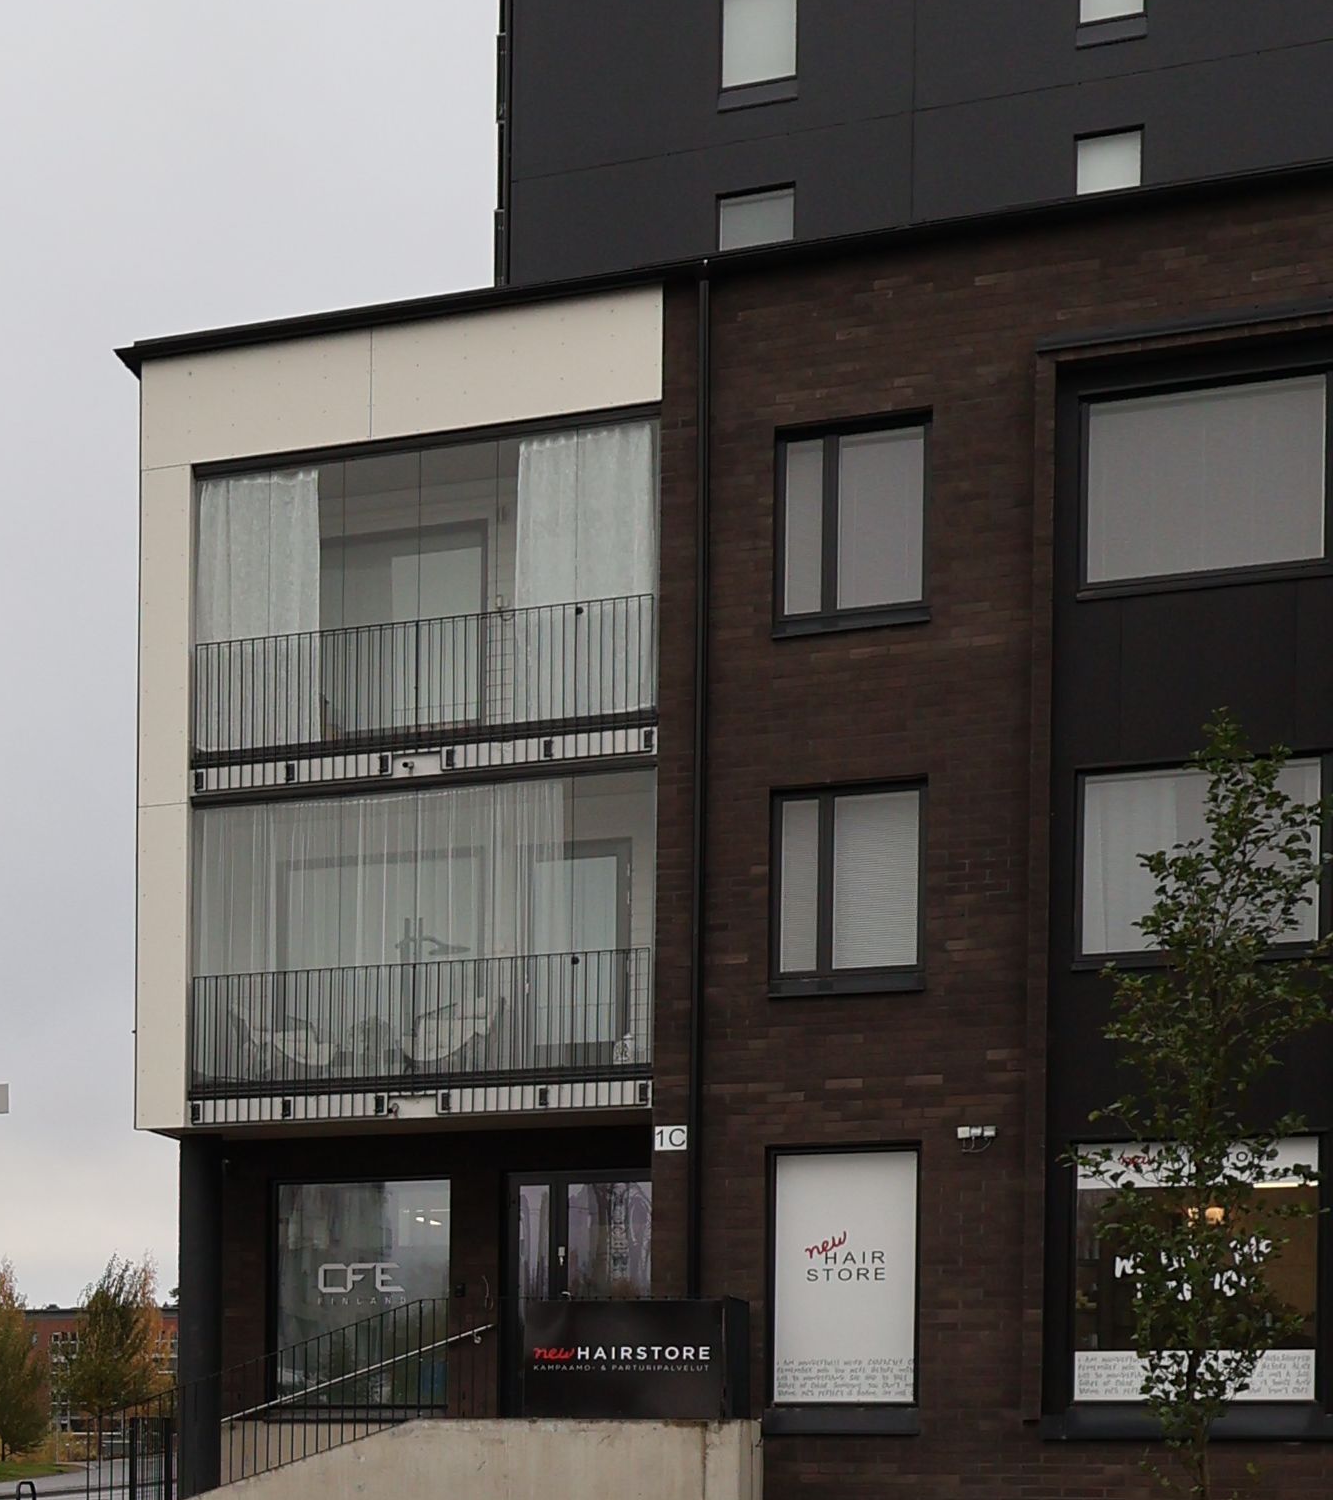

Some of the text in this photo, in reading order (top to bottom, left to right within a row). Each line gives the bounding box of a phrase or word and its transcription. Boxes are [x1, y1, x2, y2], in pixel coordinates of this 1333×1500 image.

[656, 1127, 686, 1148] 1C
[804, 1230, 847, 1260] new
[824, 1250, 885, 1265] HAIR
[806, 1267, 886, 1282] STORE
[317, 1297, 406, 1306] FINLAND
[533, 1345, 711, 1361] new HAIRSTORE
[533, 1363, 710, 1372] KAMPAAMO- & PARTURIPALVELUT
